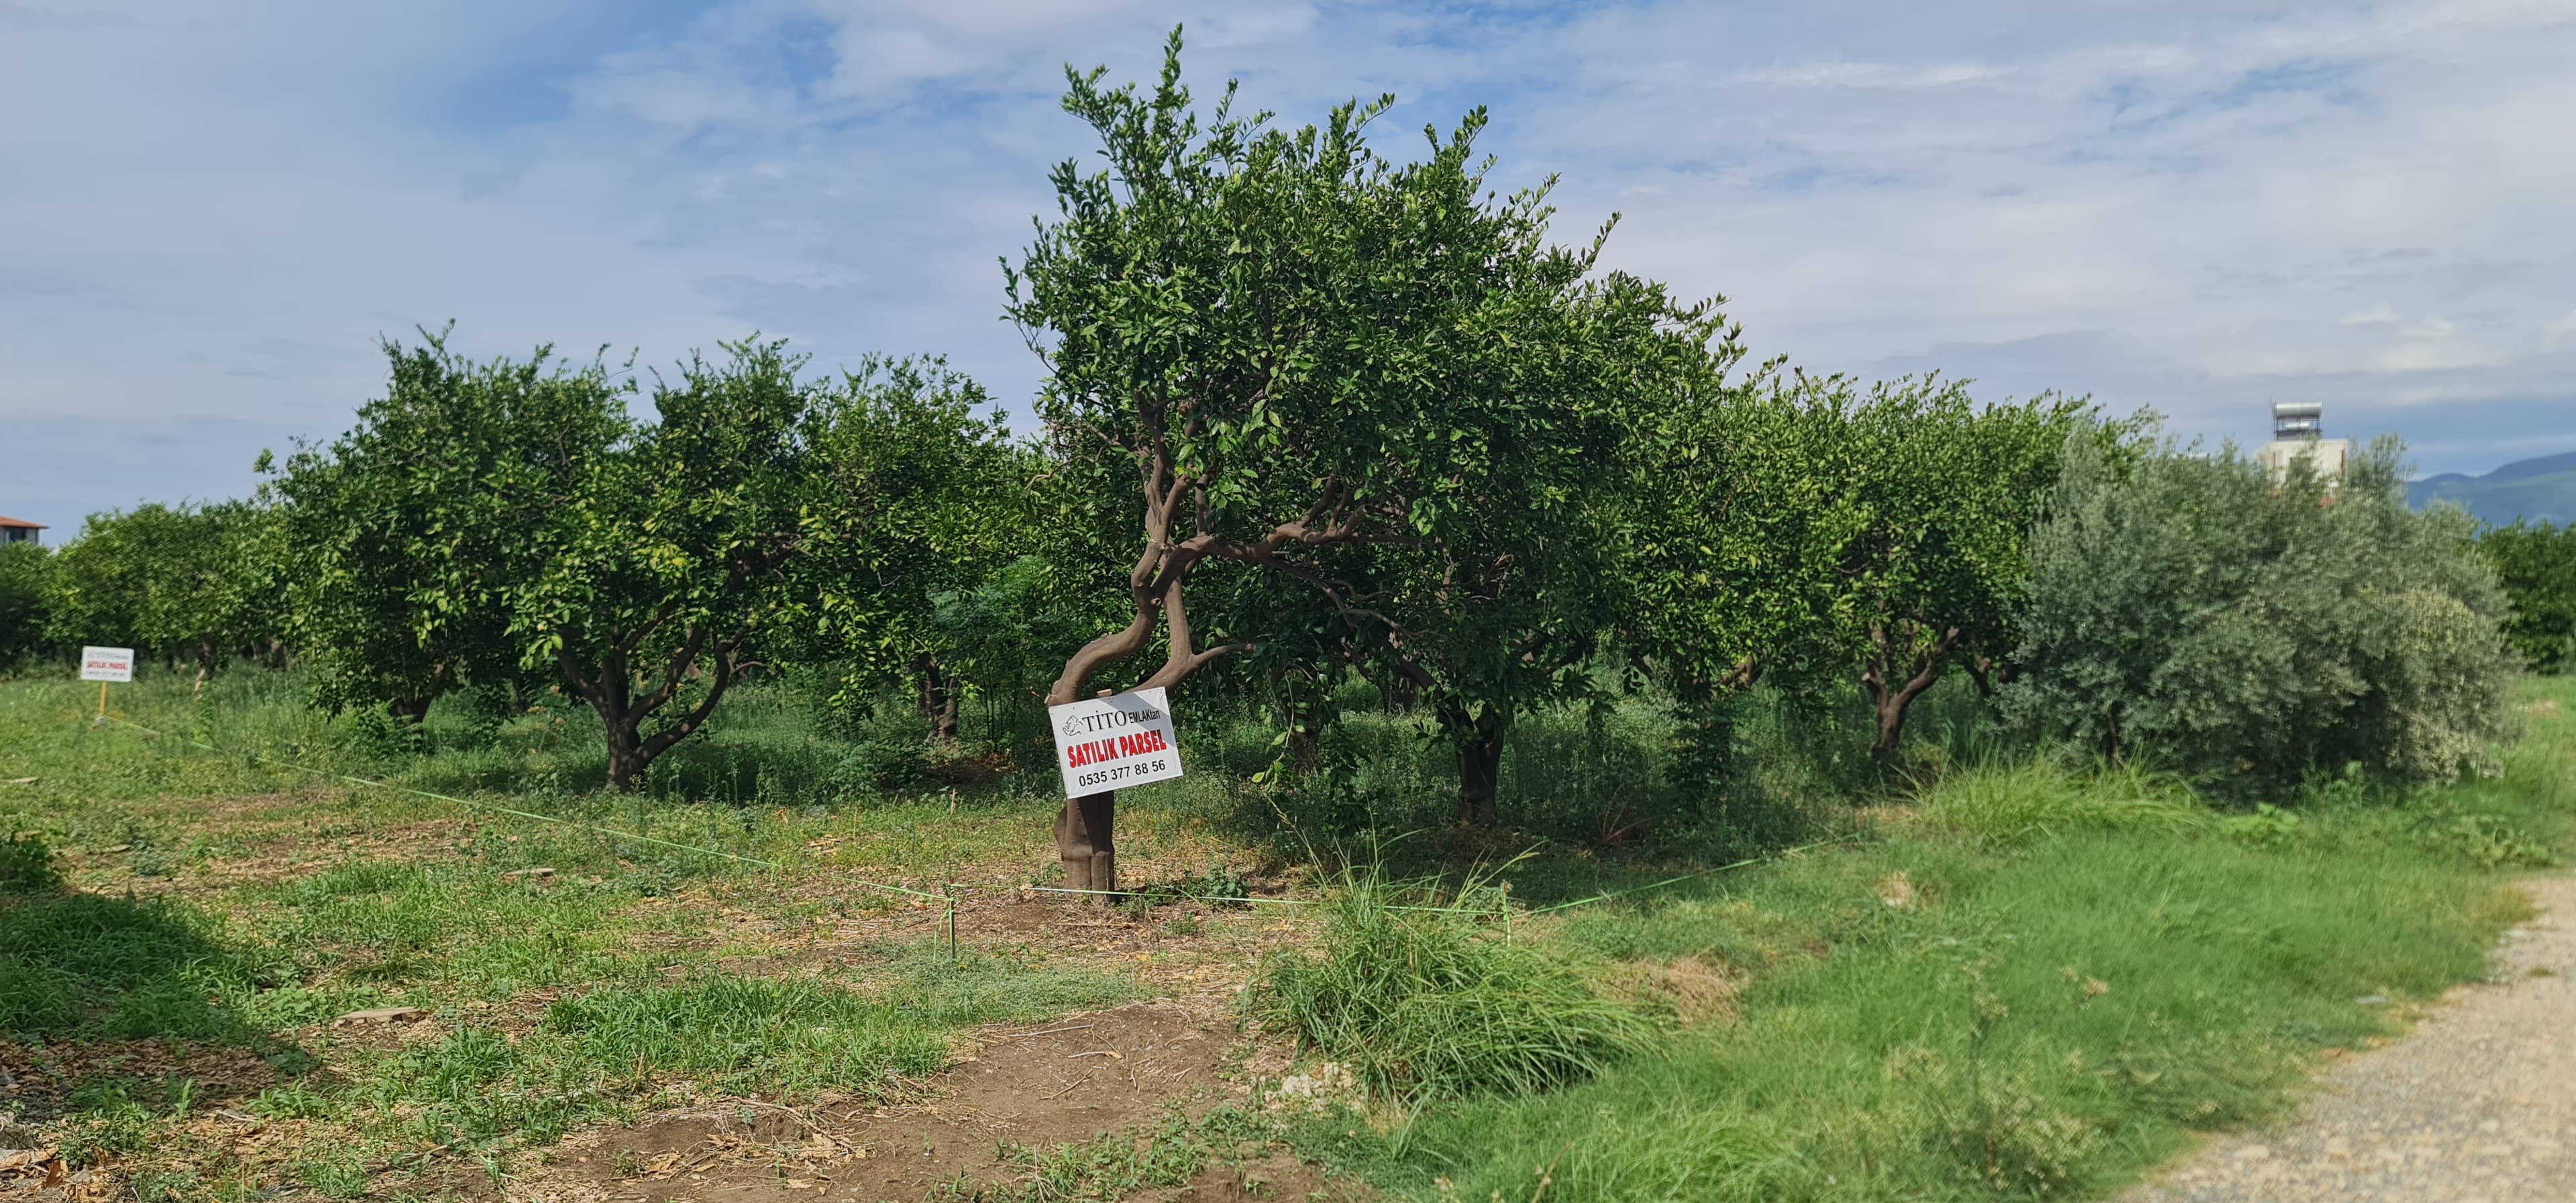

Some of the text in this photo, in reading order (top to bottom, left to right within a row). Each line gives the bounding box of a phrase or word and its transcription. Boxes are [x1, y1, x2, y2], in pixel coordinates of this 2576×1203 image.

[1082, 709, 1161, 731] TİTO EMLAKtan
[1067, 729, 1167, 768] SATILIK PARSEL
[1079, 760, 1165, 786] 0535 377 88 56
